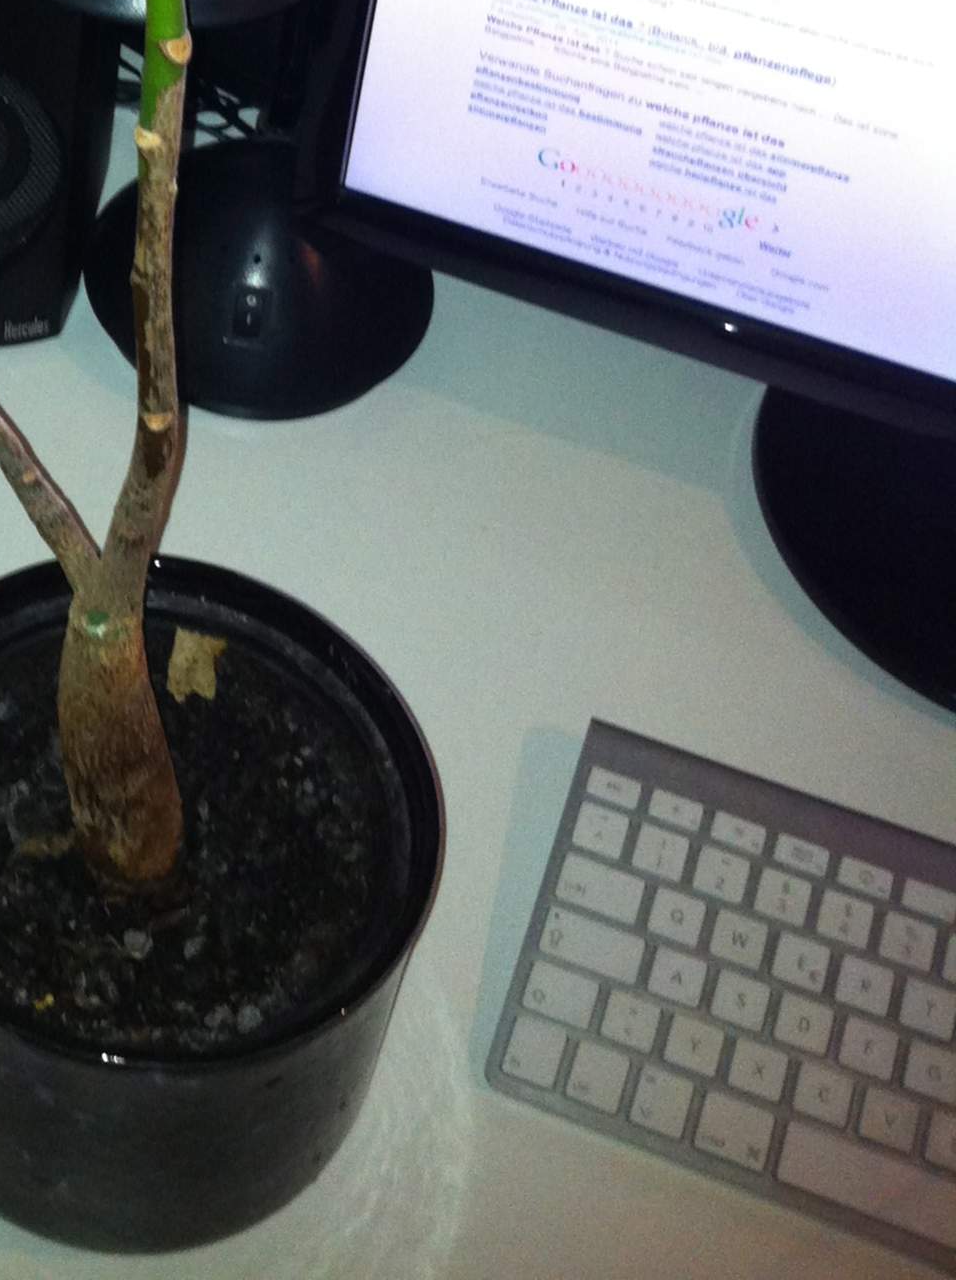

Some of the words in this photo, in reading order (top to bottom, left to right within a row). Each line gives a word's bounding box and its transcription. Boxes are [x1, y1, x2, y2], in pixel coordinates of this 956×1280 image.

[644, 97, 689, 124] welche
[691, 111, 738, 138] pflanze
[741, 126, 758, 144] ist
[760, 131, 785, 152] das
